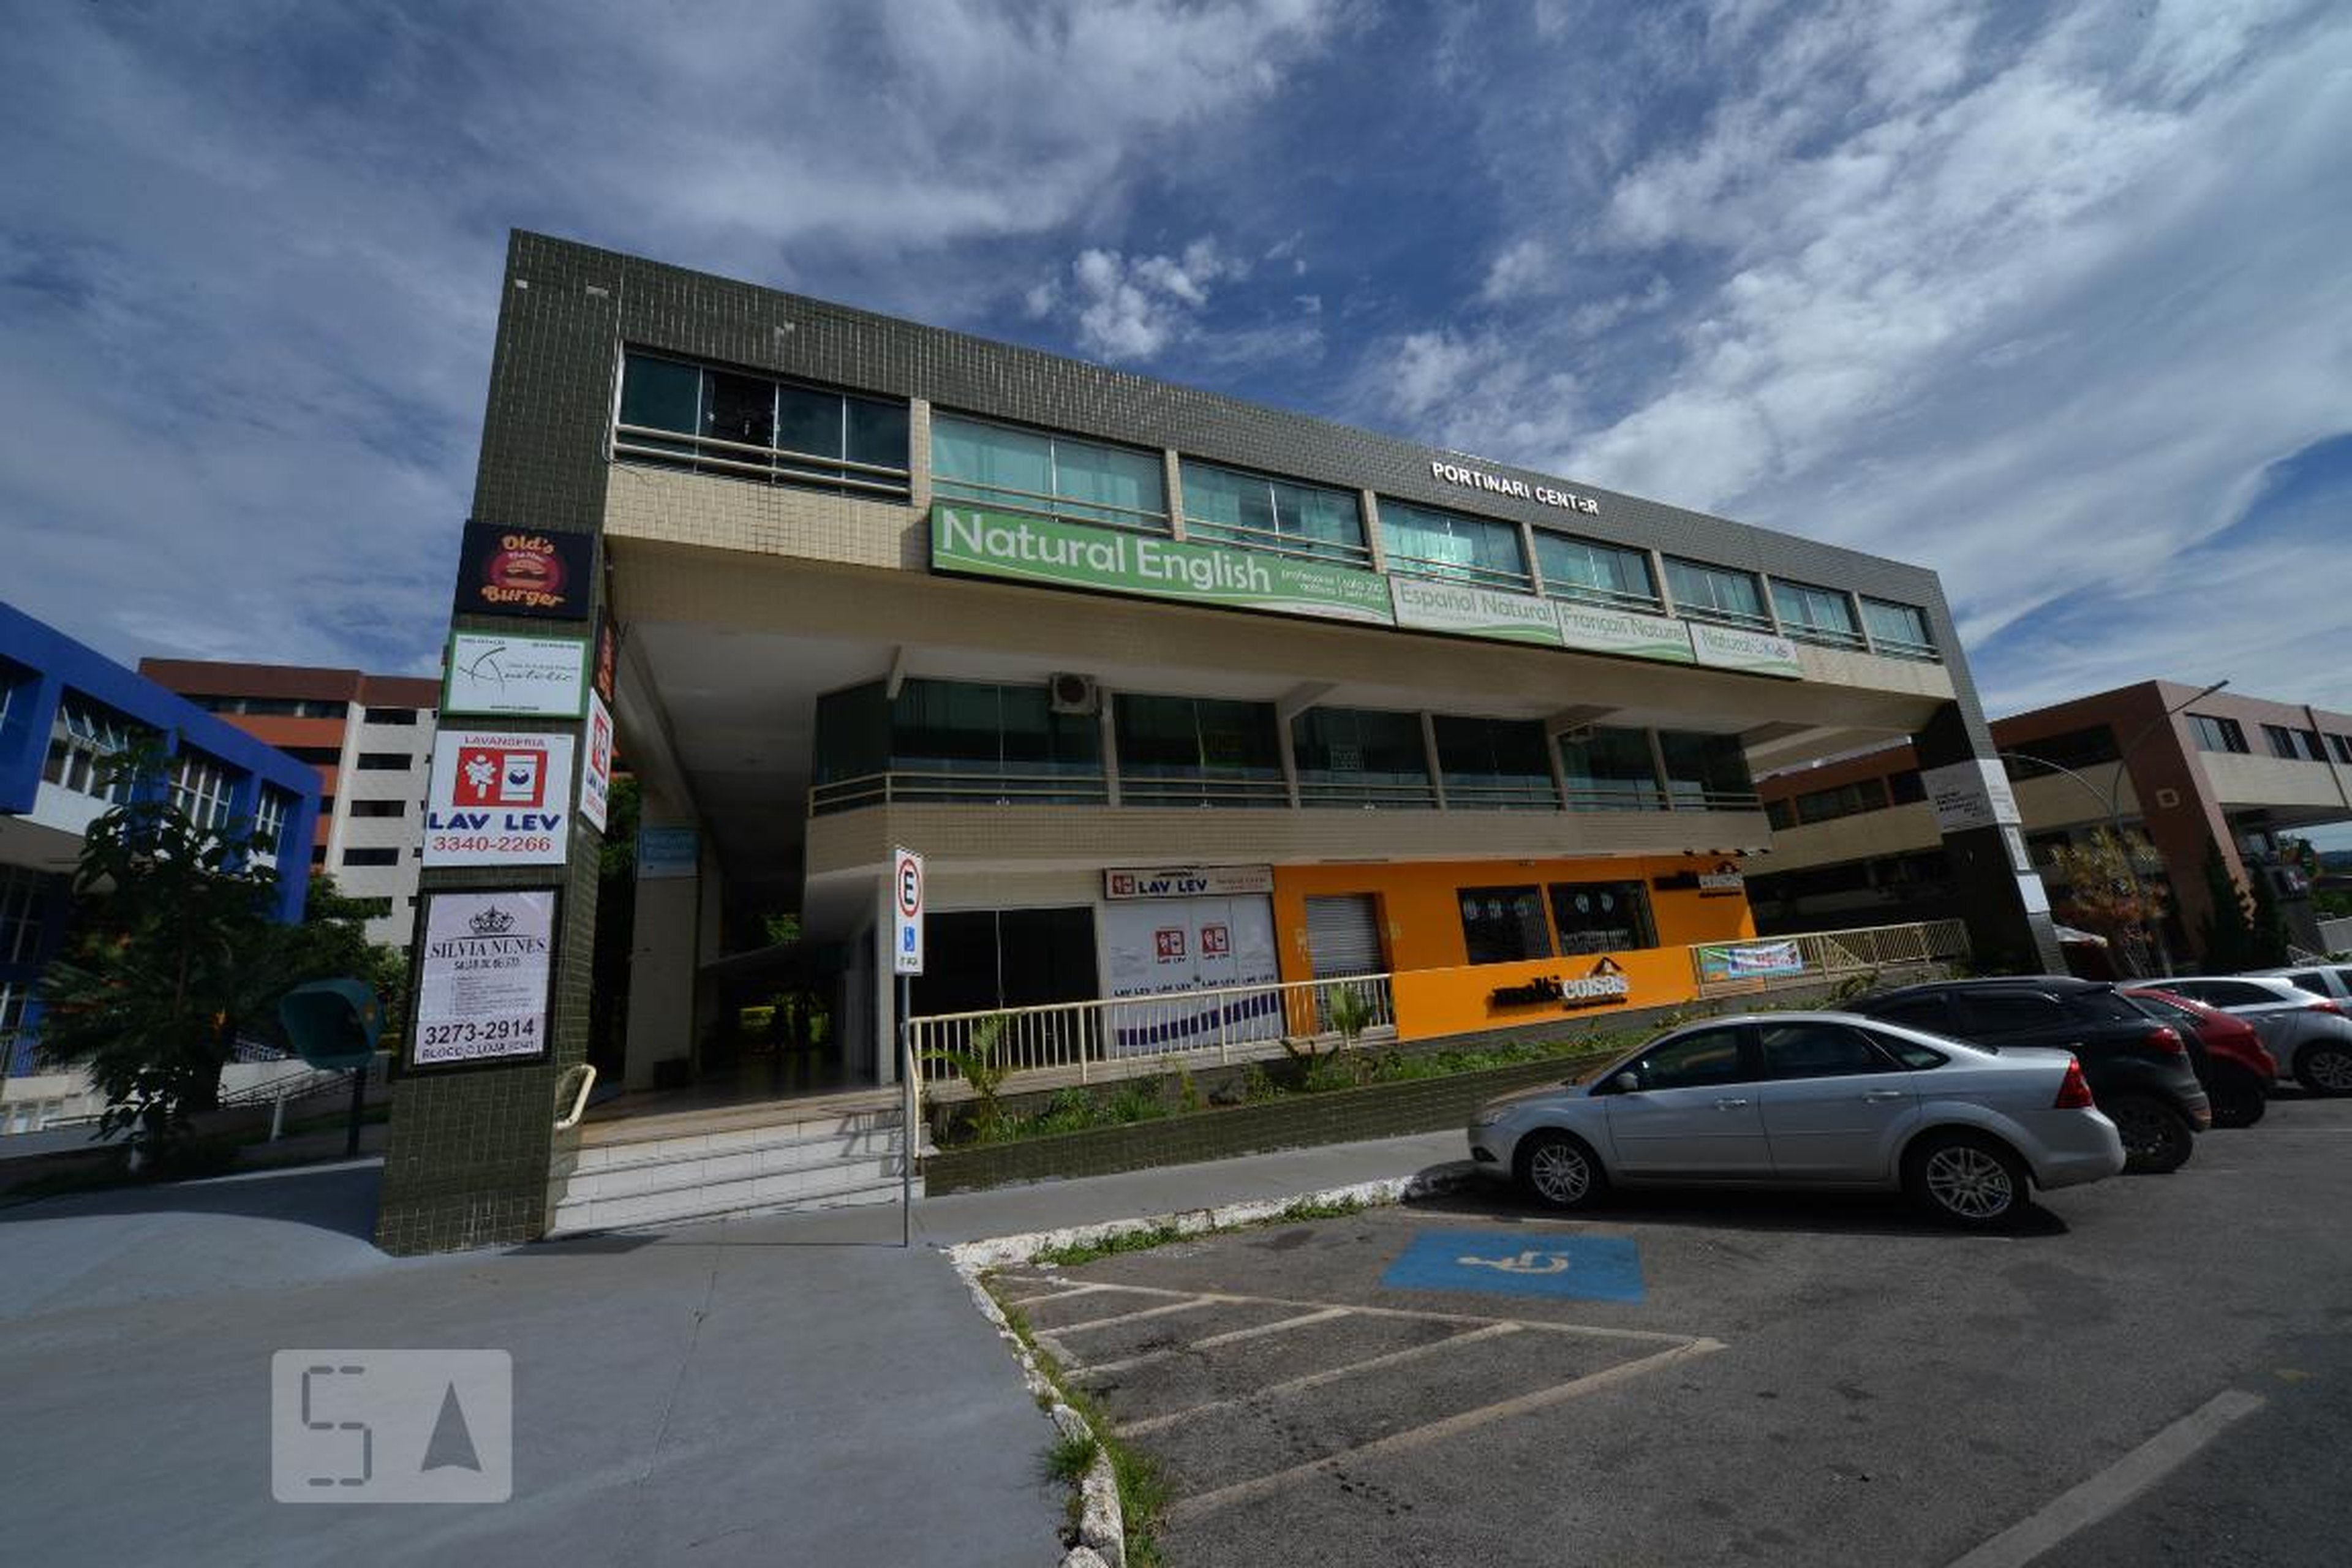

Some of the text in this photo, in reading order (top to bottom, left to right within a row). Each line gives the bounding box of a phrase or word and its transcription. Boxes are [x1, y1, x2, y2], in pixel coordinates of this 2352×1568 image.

[1432, 462, 1600, 516] PORTINARI CENTER
[502, 535, 555, 554] Old's
[942, 510, 1272, 592] Natural English
[481, 586, 566, 607] Burger
[1400, 584, 1474, 610] Español
[1482, 594, 1552, 622] Natural
[464, 735, 545, 747] LAVANDERIA
[429, 812, 560, 831] LAV LEV
[433, 836, 551, 853] 3340-2266
[904, 871, 914, 905] E
[1139, 881, 1170, 894] LAV
[1178, 880, 1208, 892] LEV
[430, 940, 486, 959] SILVIA
[424, 1018, 534, 1046] 3273-2914
